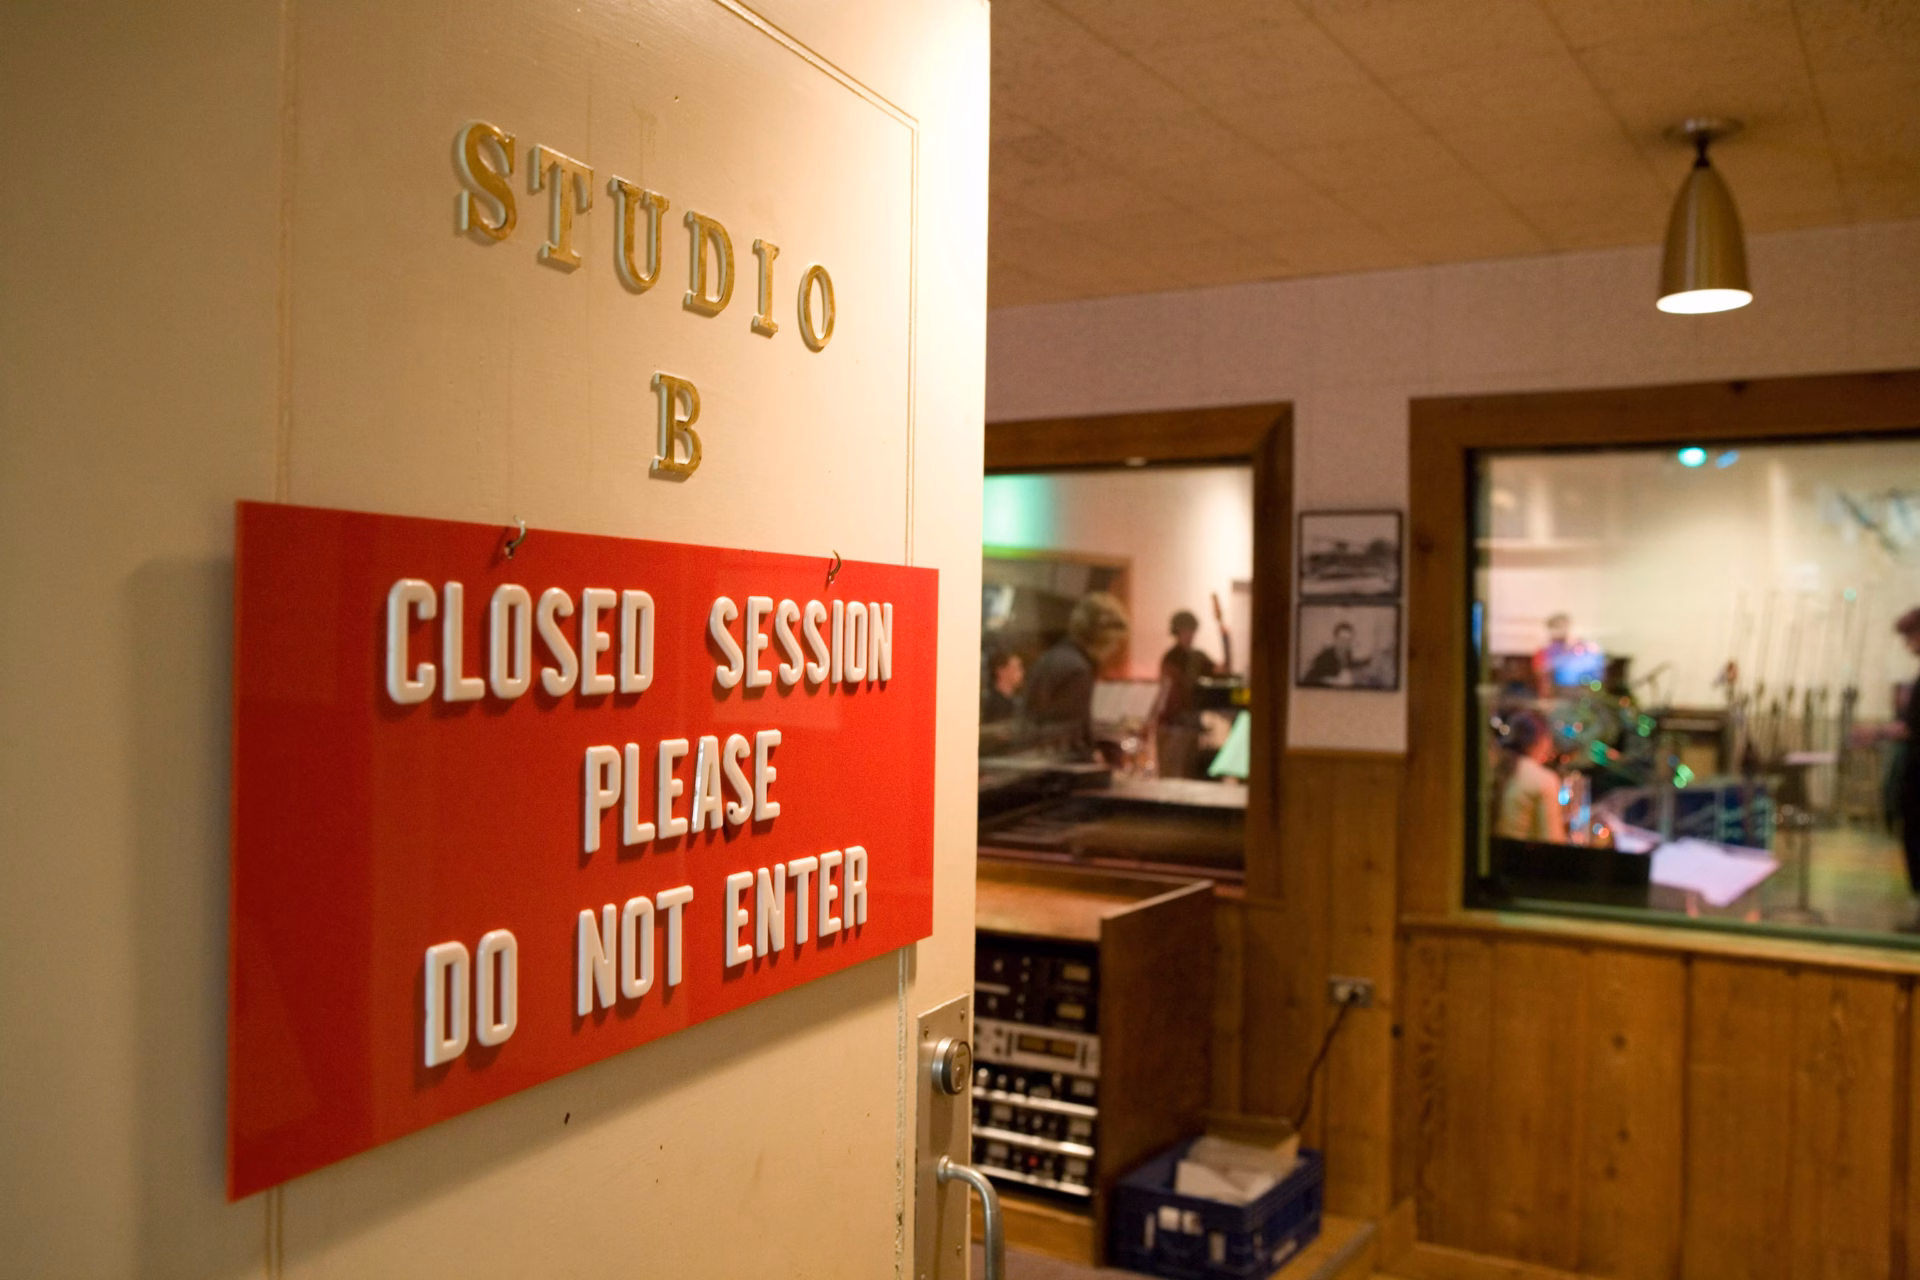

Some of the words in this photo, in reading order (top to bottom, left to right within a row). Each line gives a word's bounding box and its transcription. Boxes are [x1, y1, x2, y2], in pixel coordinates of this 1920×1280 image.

[456, 120, 836, 350] STUDIO
[652, 371, 702, 477] B
[387, 577, 655, 704] CLOSED
[709, 595, 893, 689] SESSION
[584, 729, 782, 854] PLEASE
[425, 928, 518, 1068] DO
[577, 885, 694, 1017] NOT
[726, 845, 868, 968] ENTER
